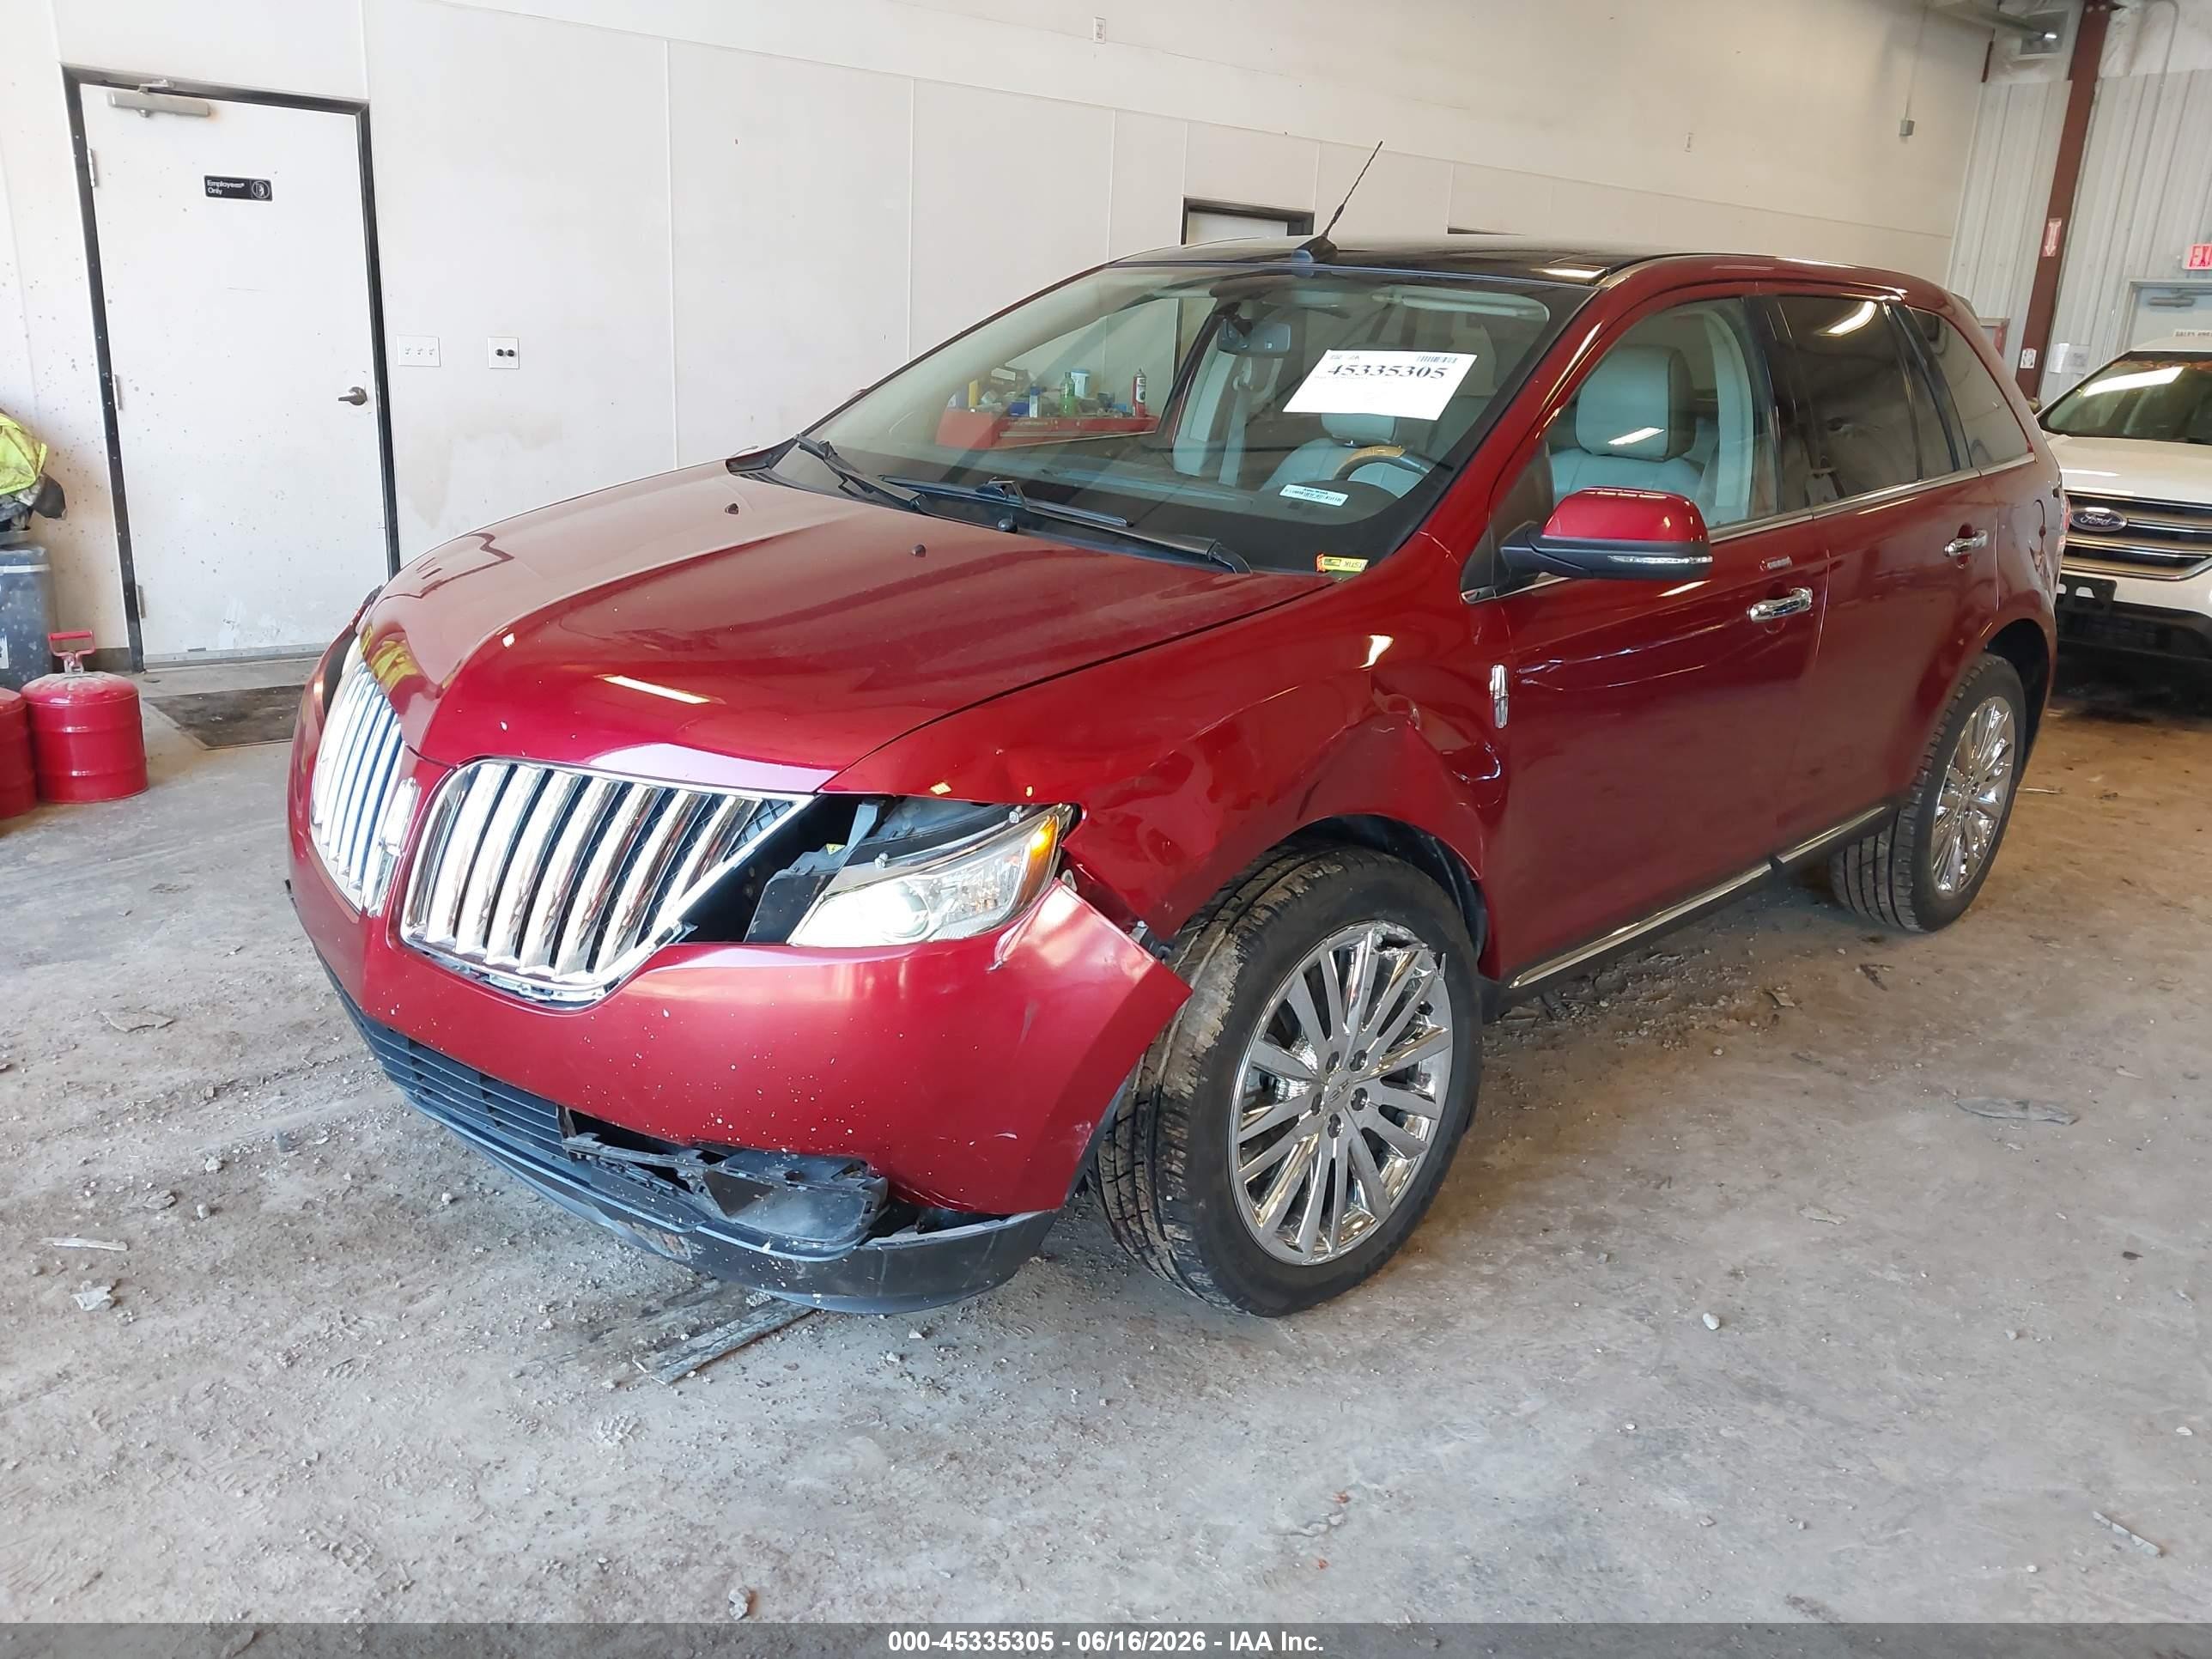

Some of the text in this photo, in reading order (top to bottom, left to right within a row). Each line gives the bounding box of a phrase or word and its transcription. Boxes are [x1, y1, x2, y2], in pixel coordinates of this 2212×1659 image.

[207, 186, 222, 195] Only
[1328, 363, 1449, 380] 45335305
[2080, 512, 2113, 526] Ford
